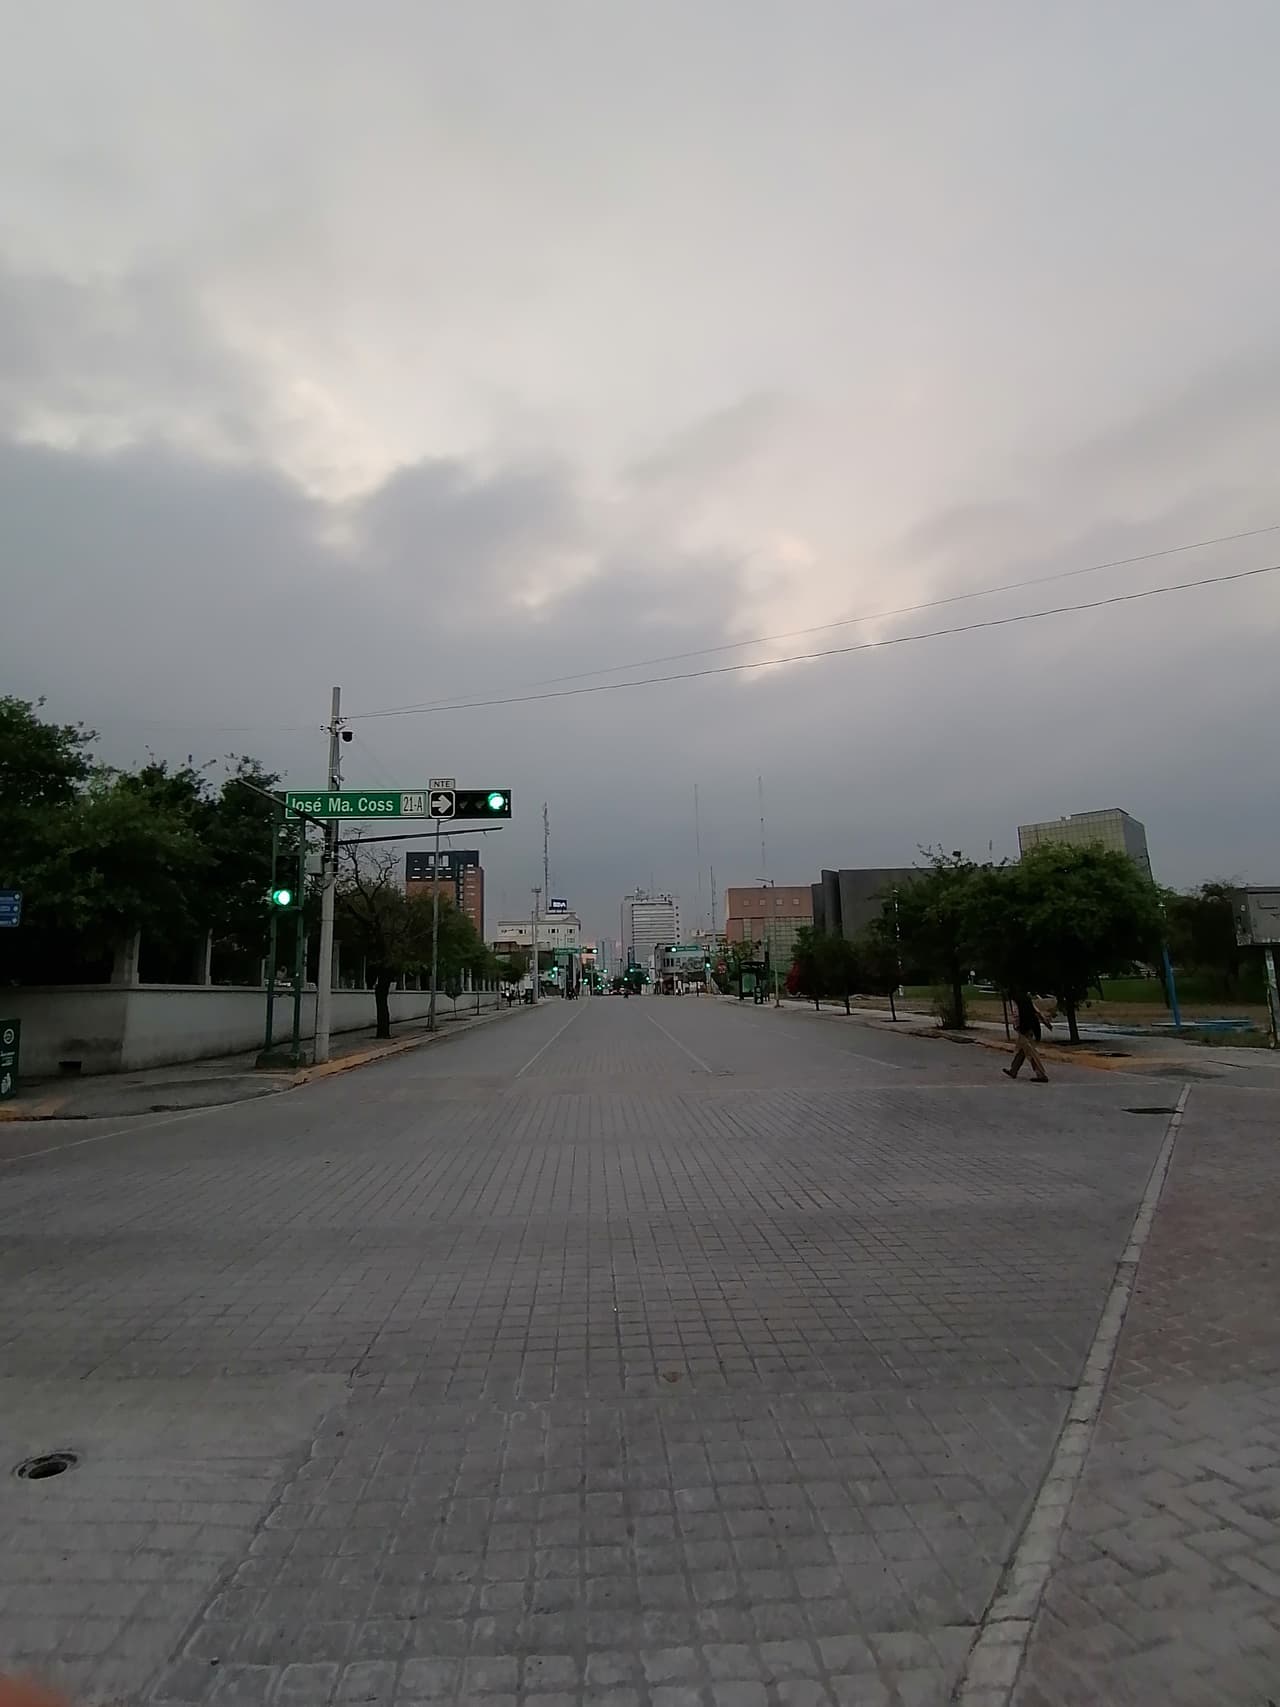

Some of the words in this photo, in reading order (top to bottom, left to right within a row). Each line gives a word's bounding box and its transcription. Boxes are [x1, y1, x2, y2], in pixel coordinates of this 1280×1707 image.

[433, 780, 451, 788] NTE
[288, 797, 322, 812] José
[328, 797, 354, 812] Ma.
[358, 797, 394, 812] Coss
[403, 797, 423, 812] 21-A
